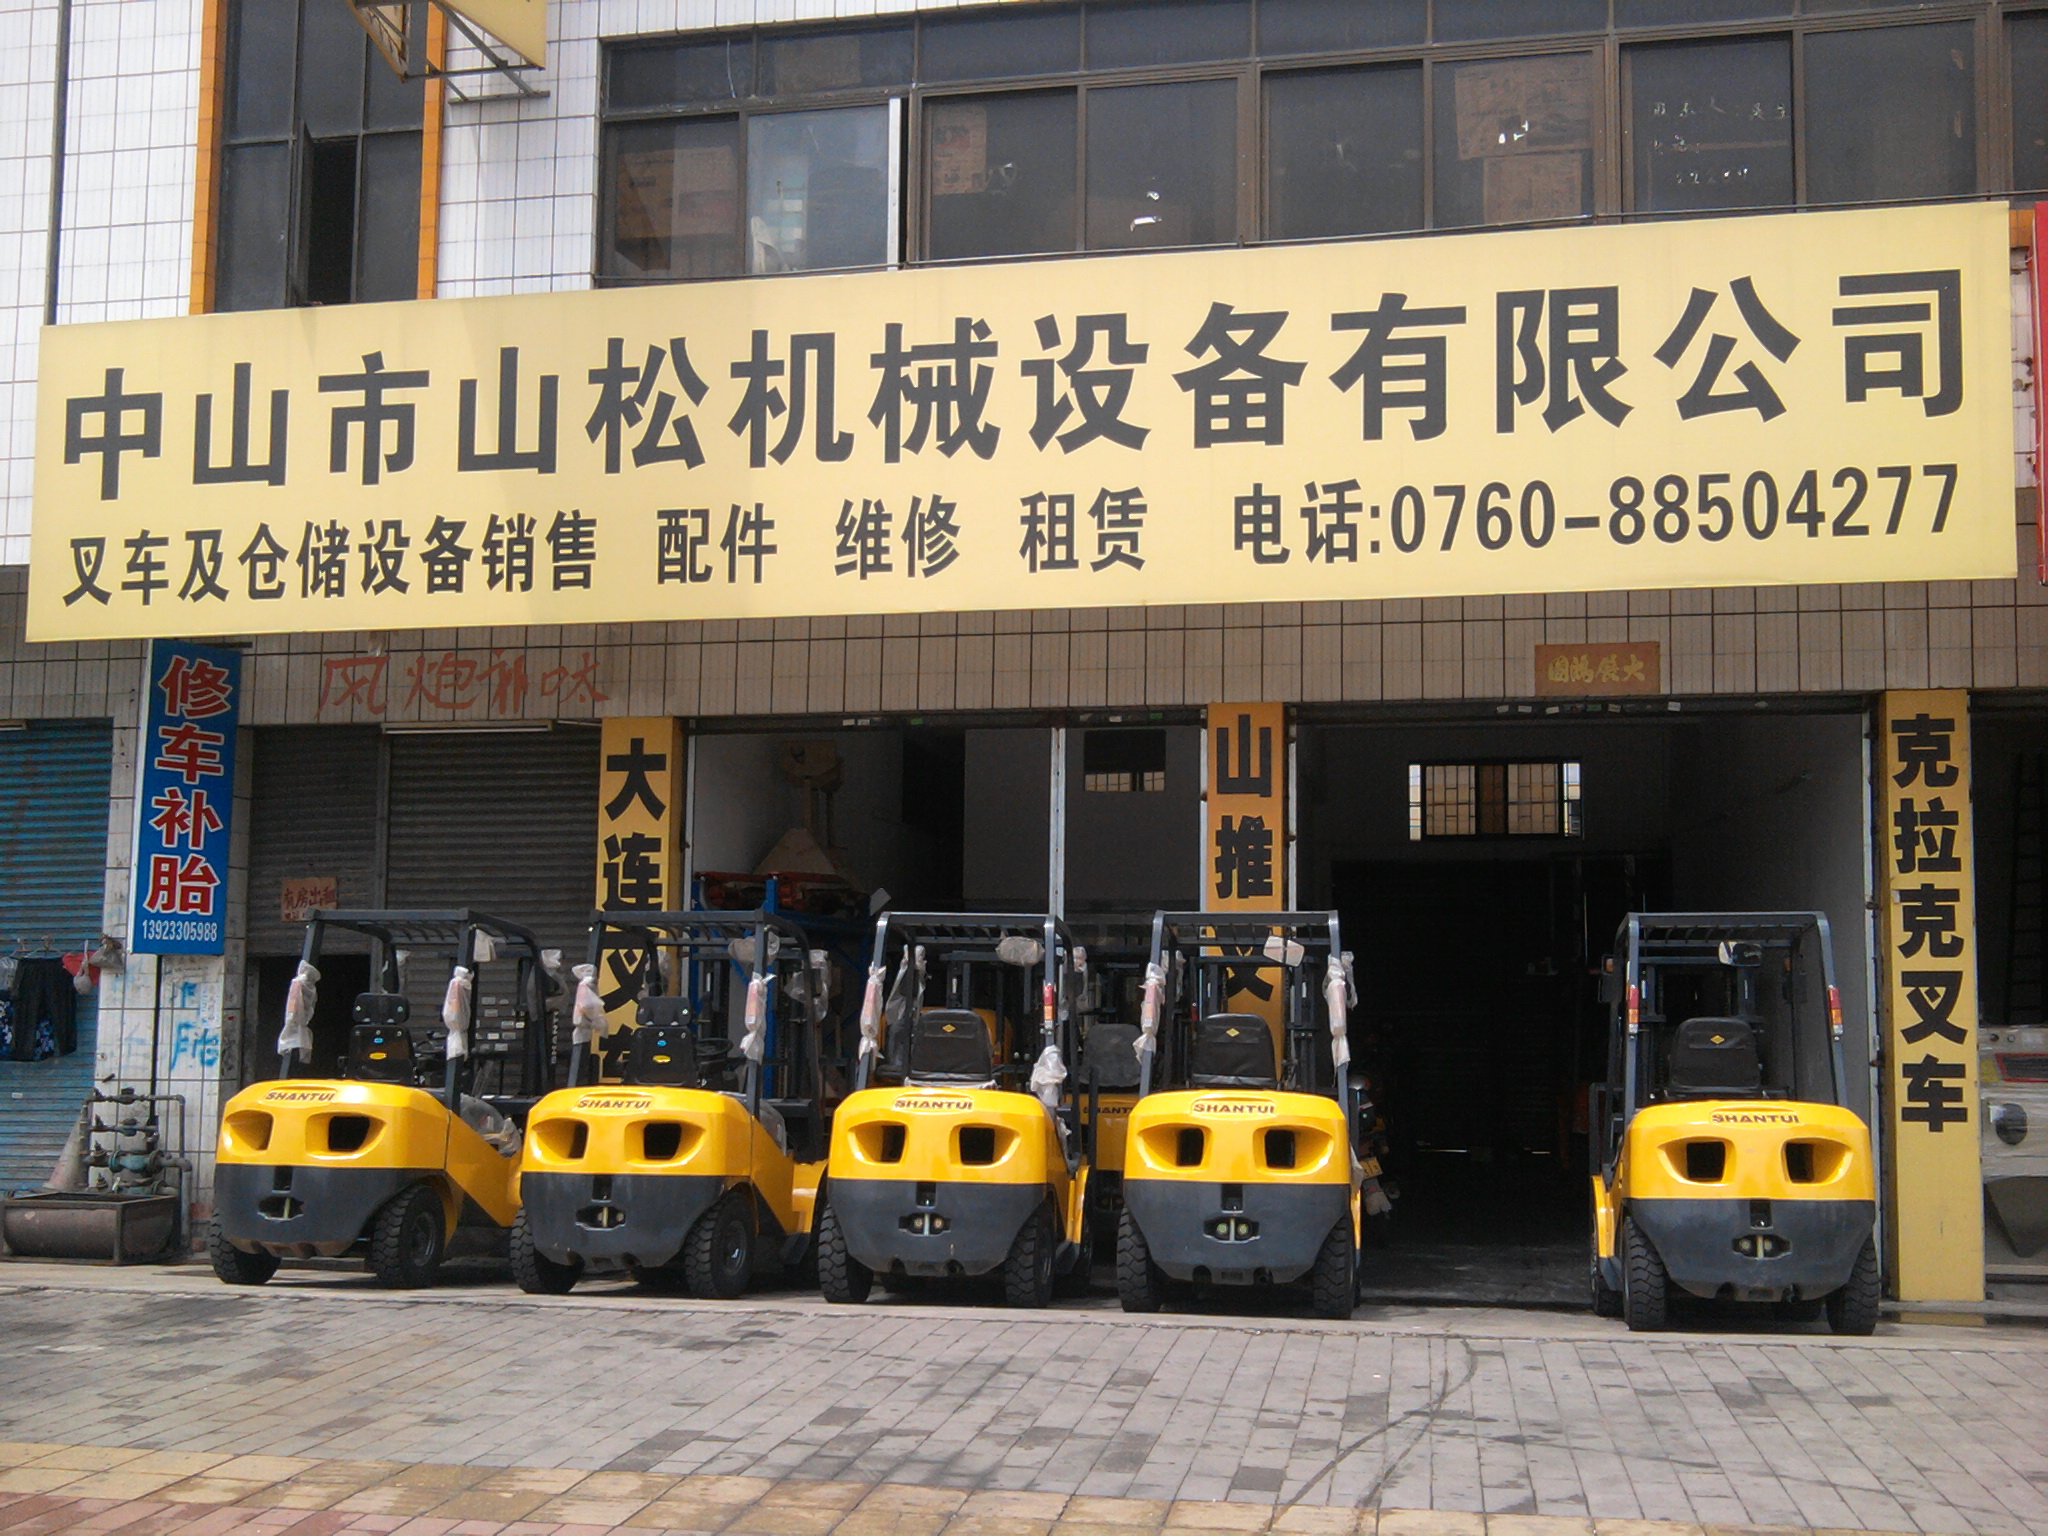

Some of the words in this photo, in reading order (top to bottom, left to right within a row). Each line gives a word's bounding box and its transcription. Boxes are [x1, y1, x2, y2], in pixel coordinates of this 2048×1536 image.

[64, 269, 1964, 500] 中山市山松机械设备有限公司
[63, 509, 597, 606] 叉车及仓储设备销售
[657, 503, 777, 584] 配件
[834, 493, 961, 580] 维修
[1019, 486, 1147, 573] 租赁
[143, 654, 232, 917] 修车补胎
[143, 919, 218, 942] 13923305988
[1891, 713, 1969, 1133] 克拉克叉车
[265, 1091, 335, 1102] SHANTUI
[577, 1099, 652, 1109] SHANTUI
[895, 1099, 973, 1110] SHANTUI
[1193, 1103, 1275, 1114] SHANTUI
[1712, 1114, 1799, 1123] SHANTUI
